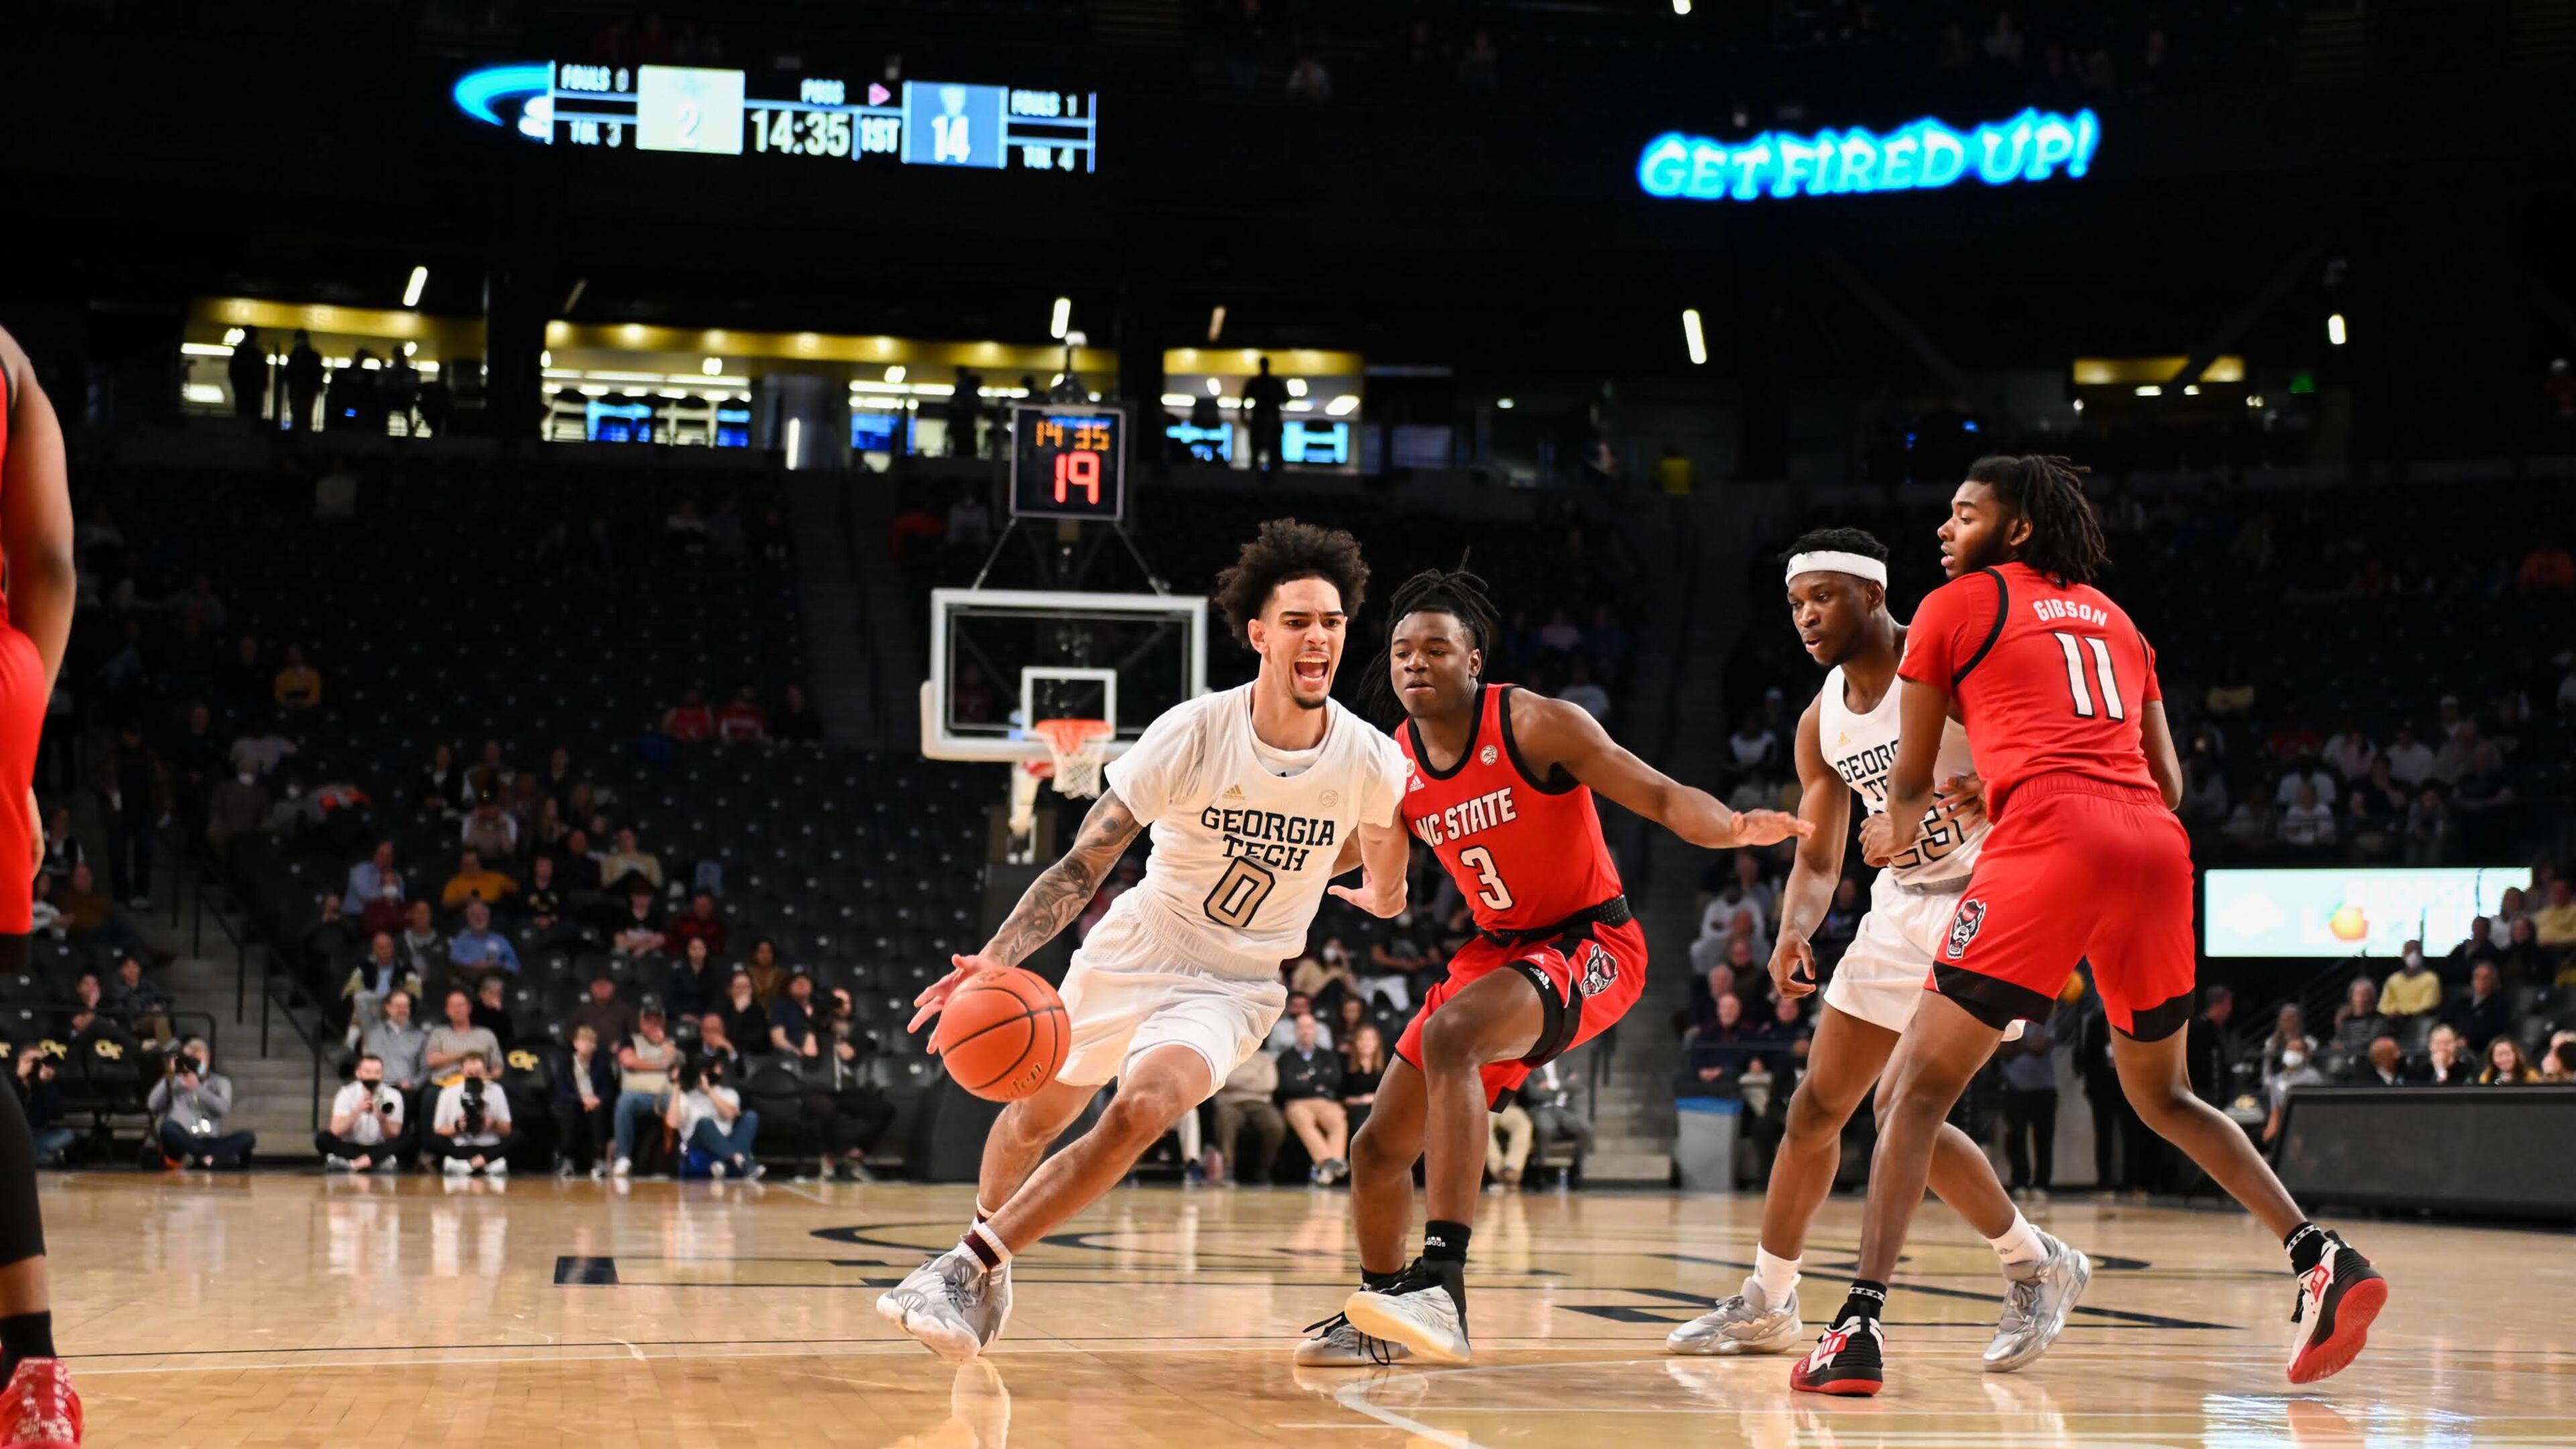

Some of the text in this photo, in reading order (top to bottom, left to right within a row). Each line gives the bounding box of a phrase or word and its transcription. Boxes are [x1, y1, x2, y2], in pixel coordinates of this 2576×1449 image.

[606, 120, 623, 148] 3
[751, 109, 901, 156] 14:35 1ST
[931, 115, 970, 163] 14
[1638, 107, 2100, 200] GET FIRED UP!
[1054, 451, 1100, 504] 19
[2033, 599, 2108, 627] GIBSON
[2052, 630, 2125, 722] 11
[1201, 806, 1335, 846] GEORGIA
[1415, 787, 1517, 847] NC STATE
[1222, 834, 1310, 871] TECH
[1459, 845, 1513, 910] 3
[1203, 855, 1276, 928] 0
